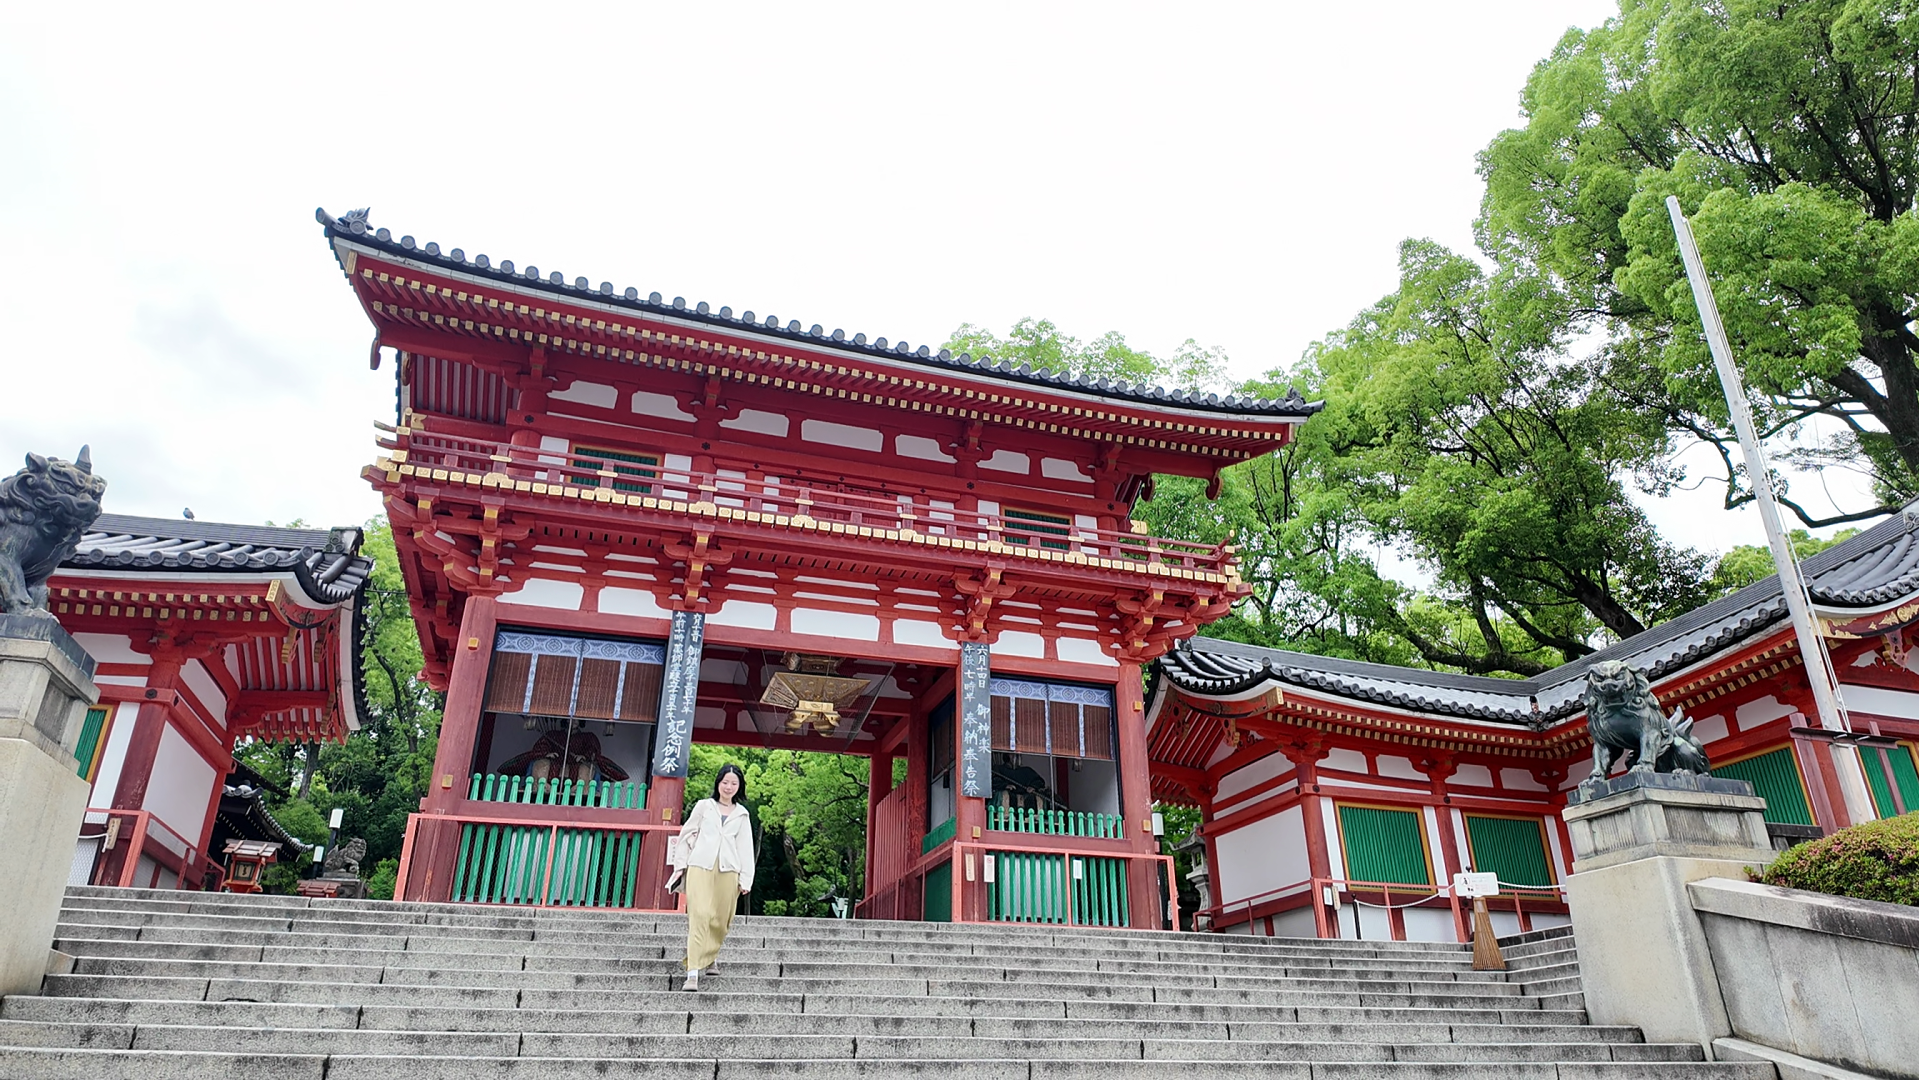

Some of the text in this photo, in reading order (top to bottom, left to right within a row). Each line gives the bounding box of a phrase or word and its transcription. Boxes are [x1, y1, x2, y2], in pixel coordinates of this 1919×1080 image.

[976, 645, 988, 688] 六月十四日
[660, 719, 687, 773] 記念例祭
[964, 644, 980, 796] 午後七時半 奉納奉告祭
